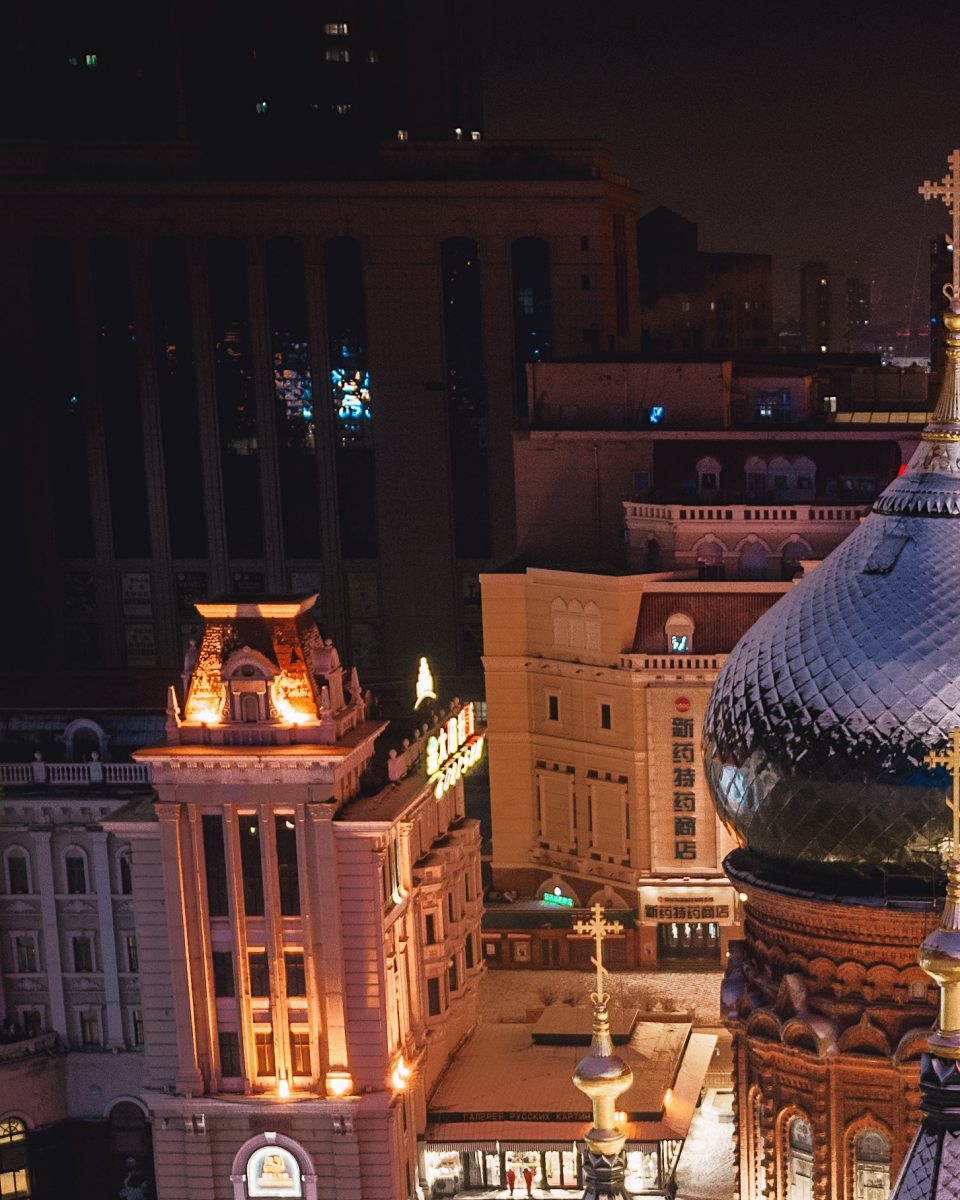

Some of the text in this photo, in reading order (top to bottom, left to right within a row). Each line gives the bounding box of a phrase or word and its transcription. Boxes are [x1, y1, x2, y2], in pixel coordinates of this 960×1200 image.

[671, 717, 697, 861] 新药特药商店
[644, 904, 730, 919] 新药特药商店
[555, 1113, 592, 1122] КАРТИН
